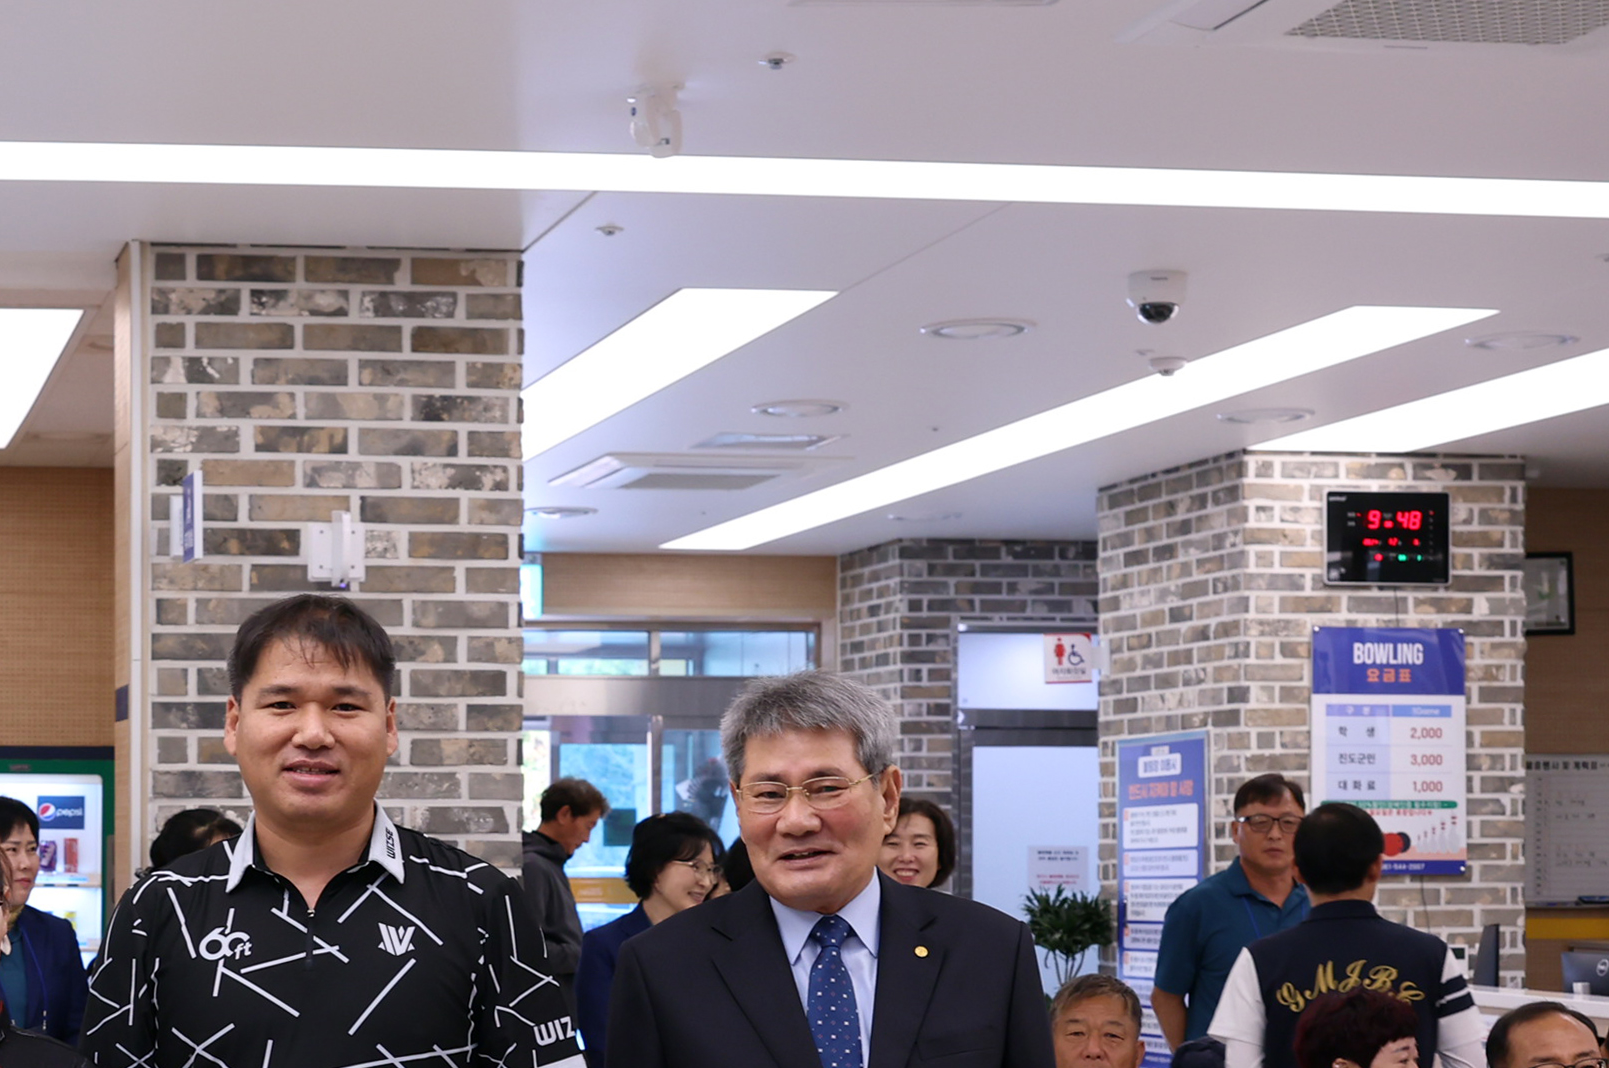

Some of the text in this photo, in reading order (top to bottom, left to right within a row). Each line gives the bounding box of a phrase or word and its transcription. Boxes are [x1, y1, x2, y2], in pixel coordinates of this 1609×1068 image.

[1352, 642, 1425, 665] BOWLING
[1410, 727, 1443, 740] 2,000
[1410, 754, 1443, 767] 3,000
[1412, 781, 1443, 794] 1,000
[55, 807, 83, 818] pepsi
[533, 1015, 576, 1047] WIZ
